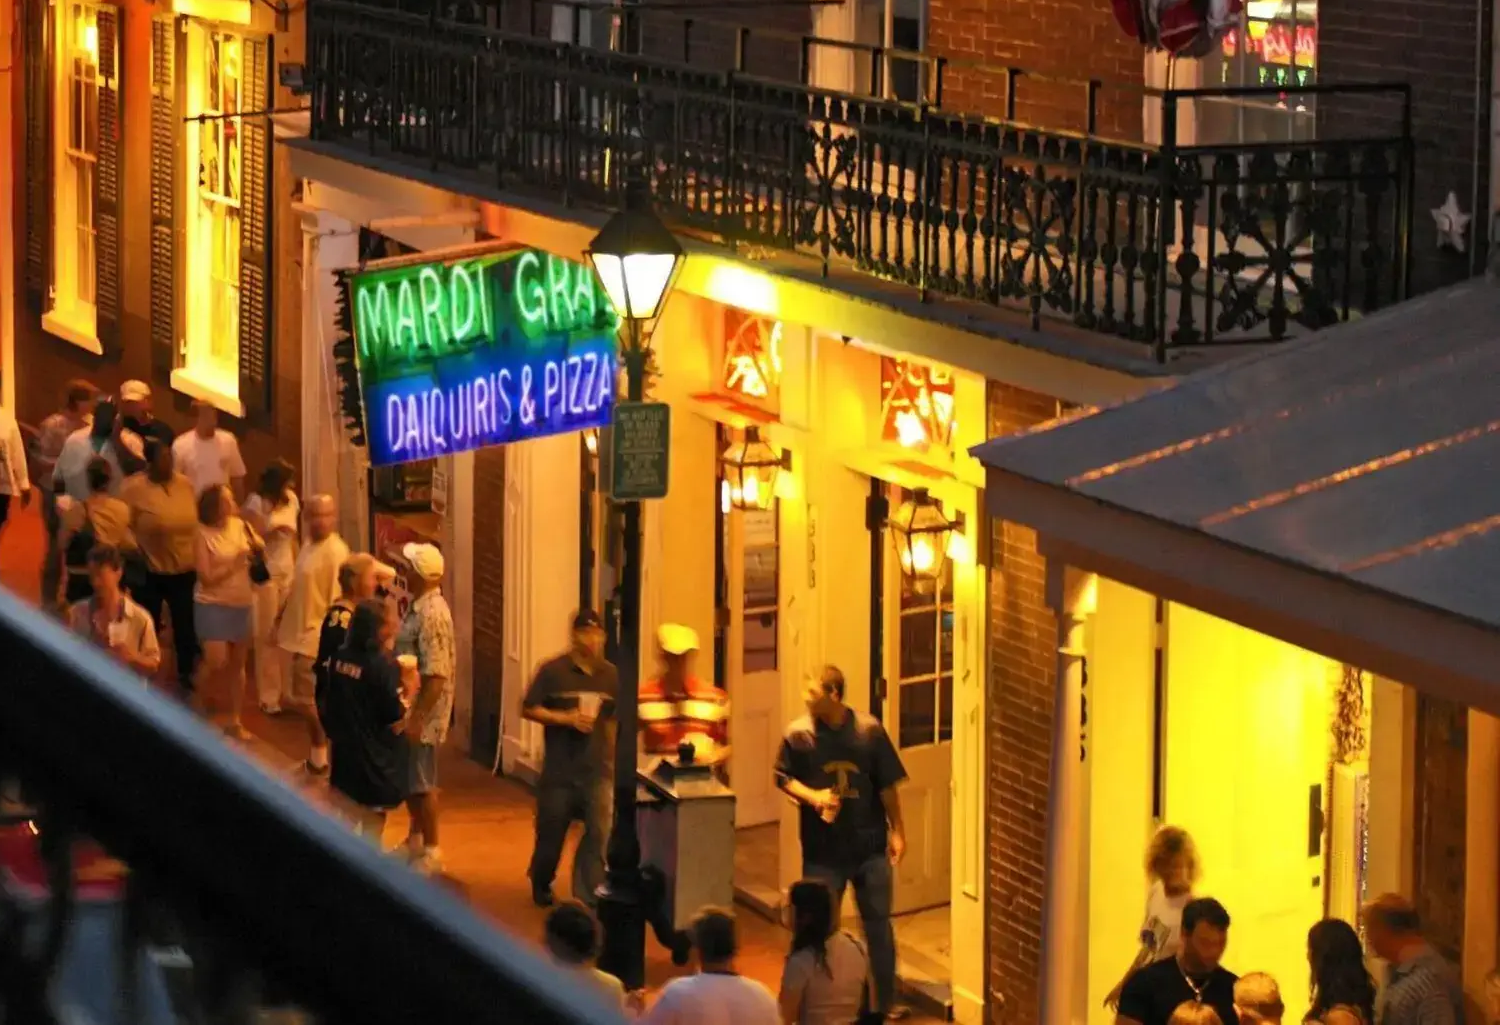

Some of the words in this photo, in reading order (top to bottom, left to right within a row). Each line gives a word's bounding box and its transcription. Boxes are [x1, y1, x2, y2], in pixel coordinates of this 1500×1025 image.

[356, 264, 492, 357] MARDI
[387, 367, 513, 453] DAIQUIRIS
[520, 363, 537, 424] &
[544, 351, 613, 419] PIZZA
